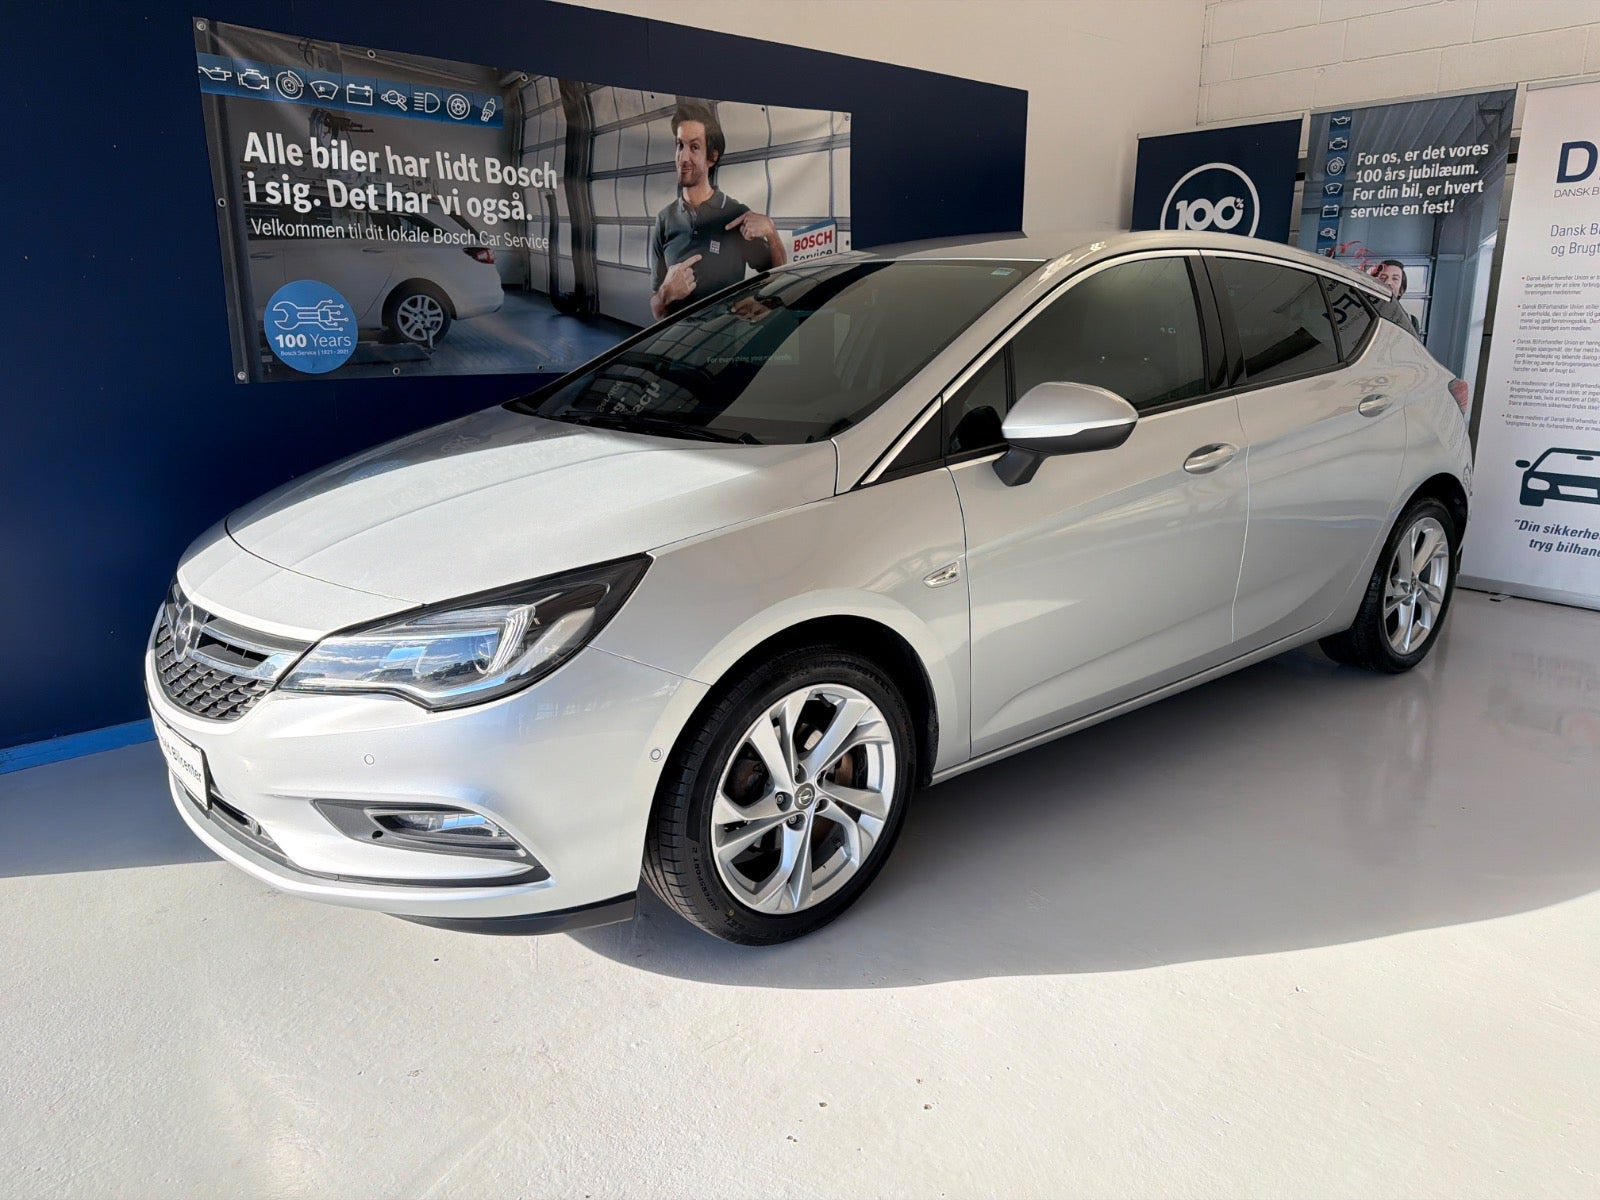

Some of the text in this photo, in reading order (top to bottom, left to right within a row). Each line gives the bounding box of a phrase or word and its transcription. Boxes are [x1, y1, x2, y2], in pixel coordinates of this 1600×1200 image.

[244, 132, 557, 189] Alle biler har lidt Bosch
[1357, 144, 1489, 166] For os, er det vores
[1556, 140, 1600, 184] D
[1356, 163, 1478, 183] 100 års jubilæum.
[247, 171, 533, 225] i sig. Det har vi også.
[1353, 180, 1483, 200] For din bil, er hvert
[1554, 188, 1590, 198] DANSK
[1350, 199, 1455, 218] service en fest!
[251, 218, 549, 249] Velkommen til dit lokale Bosch Car Service
[1550, 223, 1600, 237] Dansk B
[794, 230, 832, 252] BOSCH
[1551, 245, 1565, 257] og
[275, 334, 352, 348] 100 Years
[1543, 524, 1600, 540] sikkerhe
[1529, 539, 1554, 552] tryg
